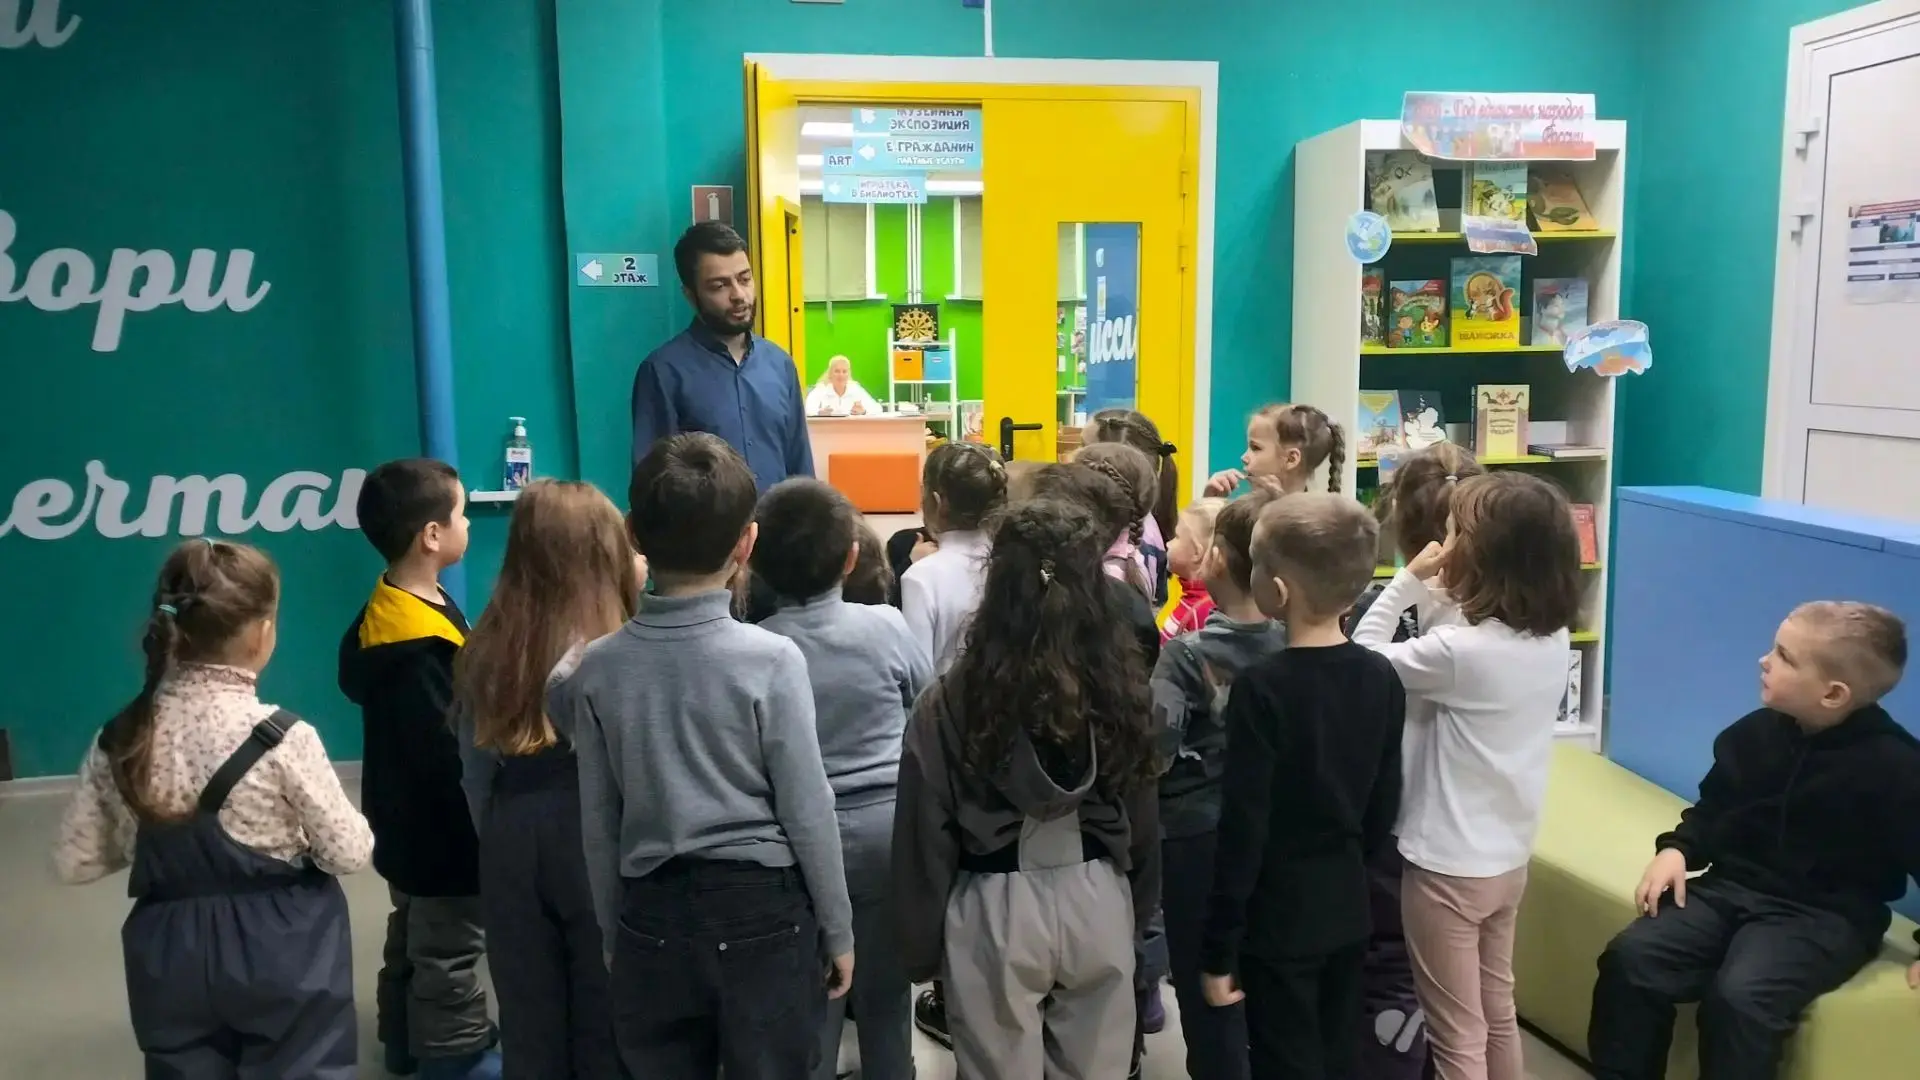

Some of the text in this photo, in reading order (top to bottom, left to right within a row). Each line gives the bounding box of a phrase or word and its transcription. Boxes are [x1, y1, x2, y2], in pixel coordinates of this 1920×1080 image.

[890, 119, 970, 131] ЭКСПОЗИЦИЯ
[898, 141, 974, 153] ГРАЖДАНИН
[828, 155, 852, 166] ART
[860, 190, 920, 199] БИБЛИОТЕКЕ
[624, 258, 636, 270] 2
[614, 273, 647, 283] ЭТАЖ
